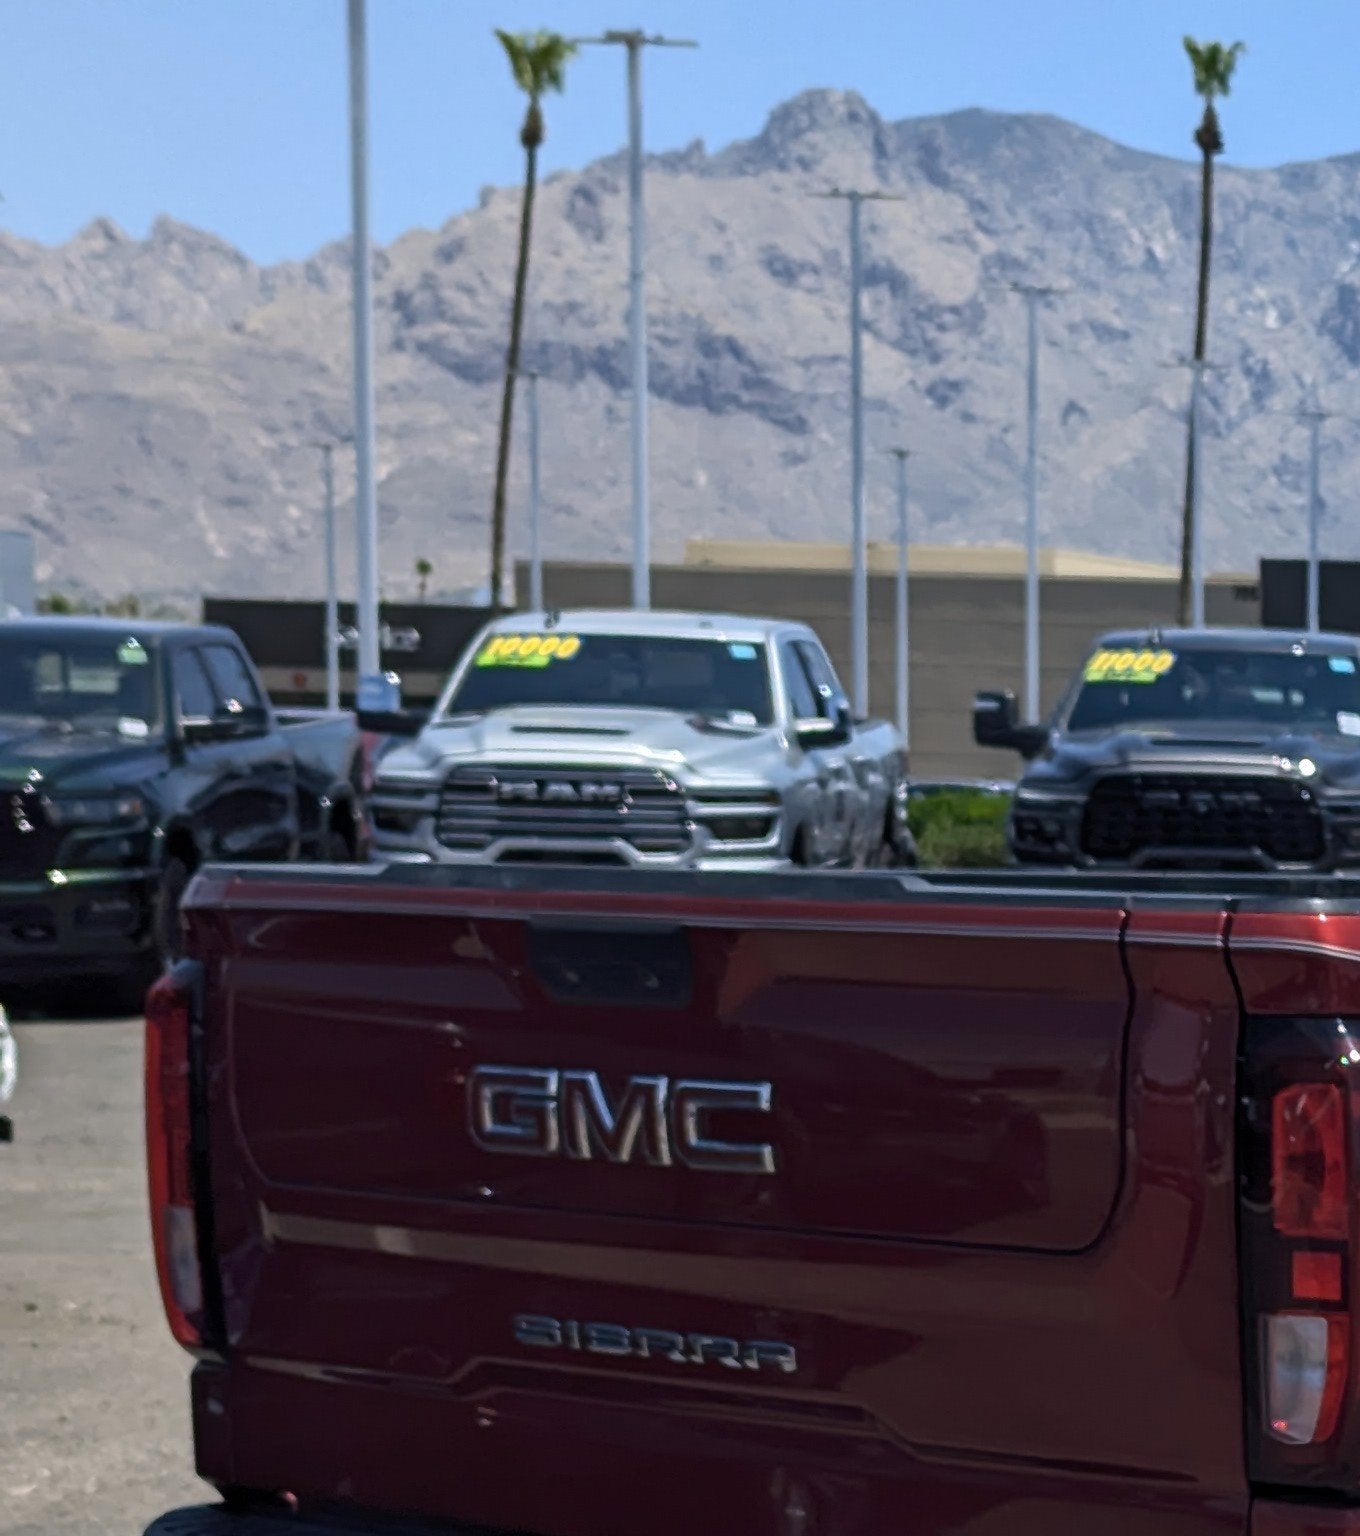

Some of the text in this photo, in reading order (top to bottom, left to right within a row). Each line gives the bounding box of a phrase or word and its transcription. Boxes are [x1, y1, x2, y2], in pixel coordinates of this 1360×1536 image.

[486, 636, 580, 659] 10000
[499, 780, 623, 802] RAM
[467, 1063, 776, 1174] GMC
[512, 1313, 797, 1373] SIERRA
